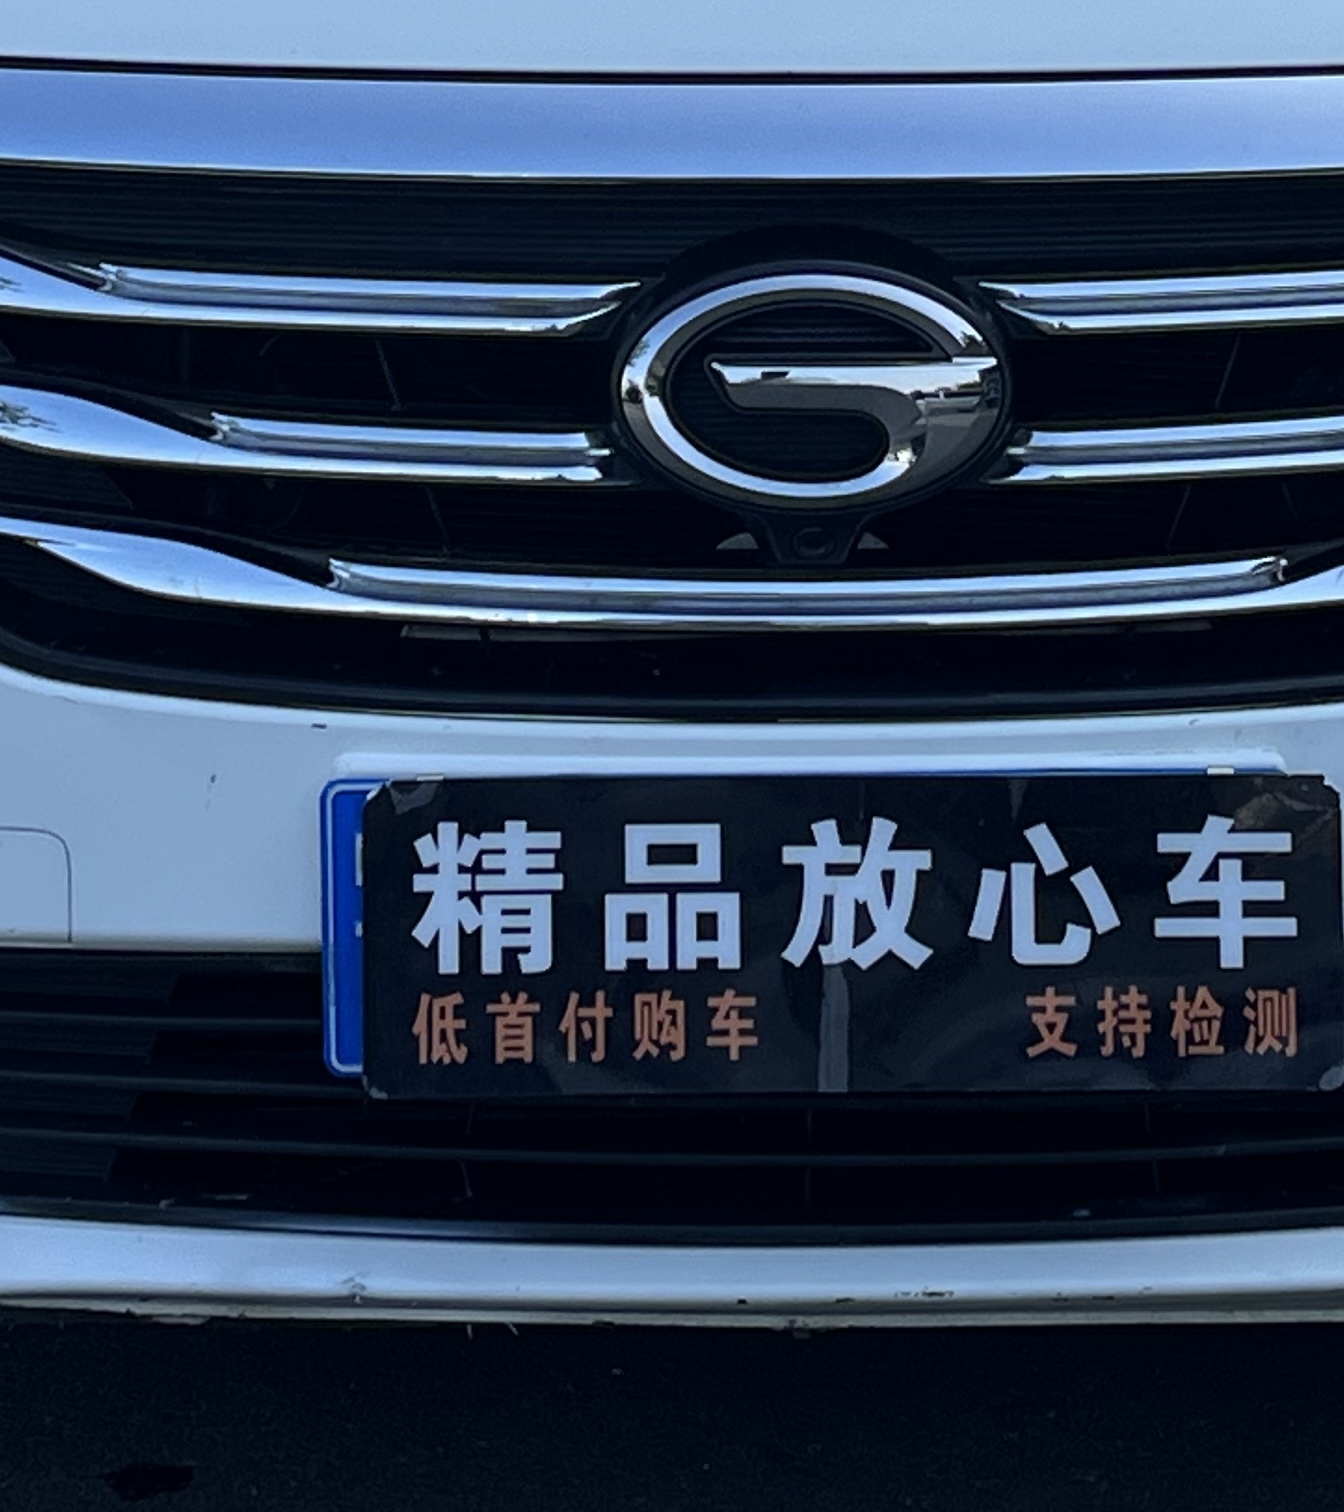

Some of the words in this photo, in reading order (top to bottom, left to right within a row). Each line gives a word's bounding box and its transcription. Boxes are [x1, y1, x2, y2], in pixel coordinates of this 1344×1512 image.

[411, 815, 1299, 975] 精品放心车
[411, 989, 760, 1066] 低首付购车
[1025, 986, 1299, 1060] 支持检测
